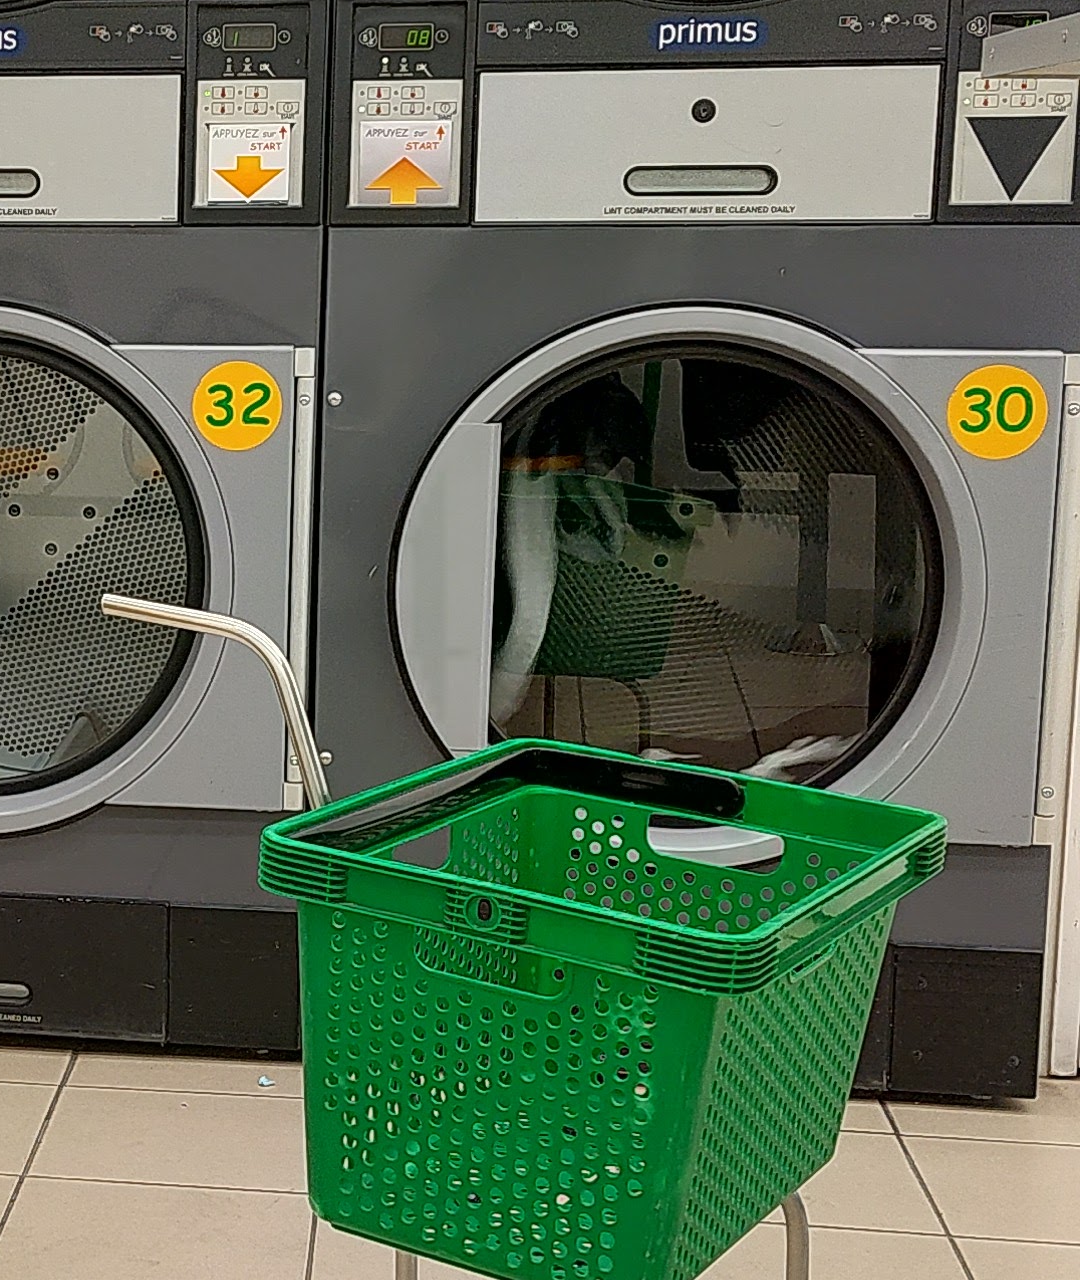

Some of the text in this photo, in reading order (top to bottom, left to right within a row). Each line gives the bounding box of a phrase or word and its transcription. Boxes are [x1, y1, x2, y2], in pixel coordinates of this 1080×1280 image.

[407, 30, 430, 46] 08
[658, 18, 758, 50] primus
[212, 129, 260, 139] APPUYEZ
[365, 128, 409, 137] APPUYEZ
[250, 142, 283, 151] START
[405, 142, 440, 150] START
[603, 205, 796, 215] LINT COMPARTMENT MUST BE CLEANED DAILY
[205, 382, 271, 427] 32
[959, 386, 1034, 434] 30
